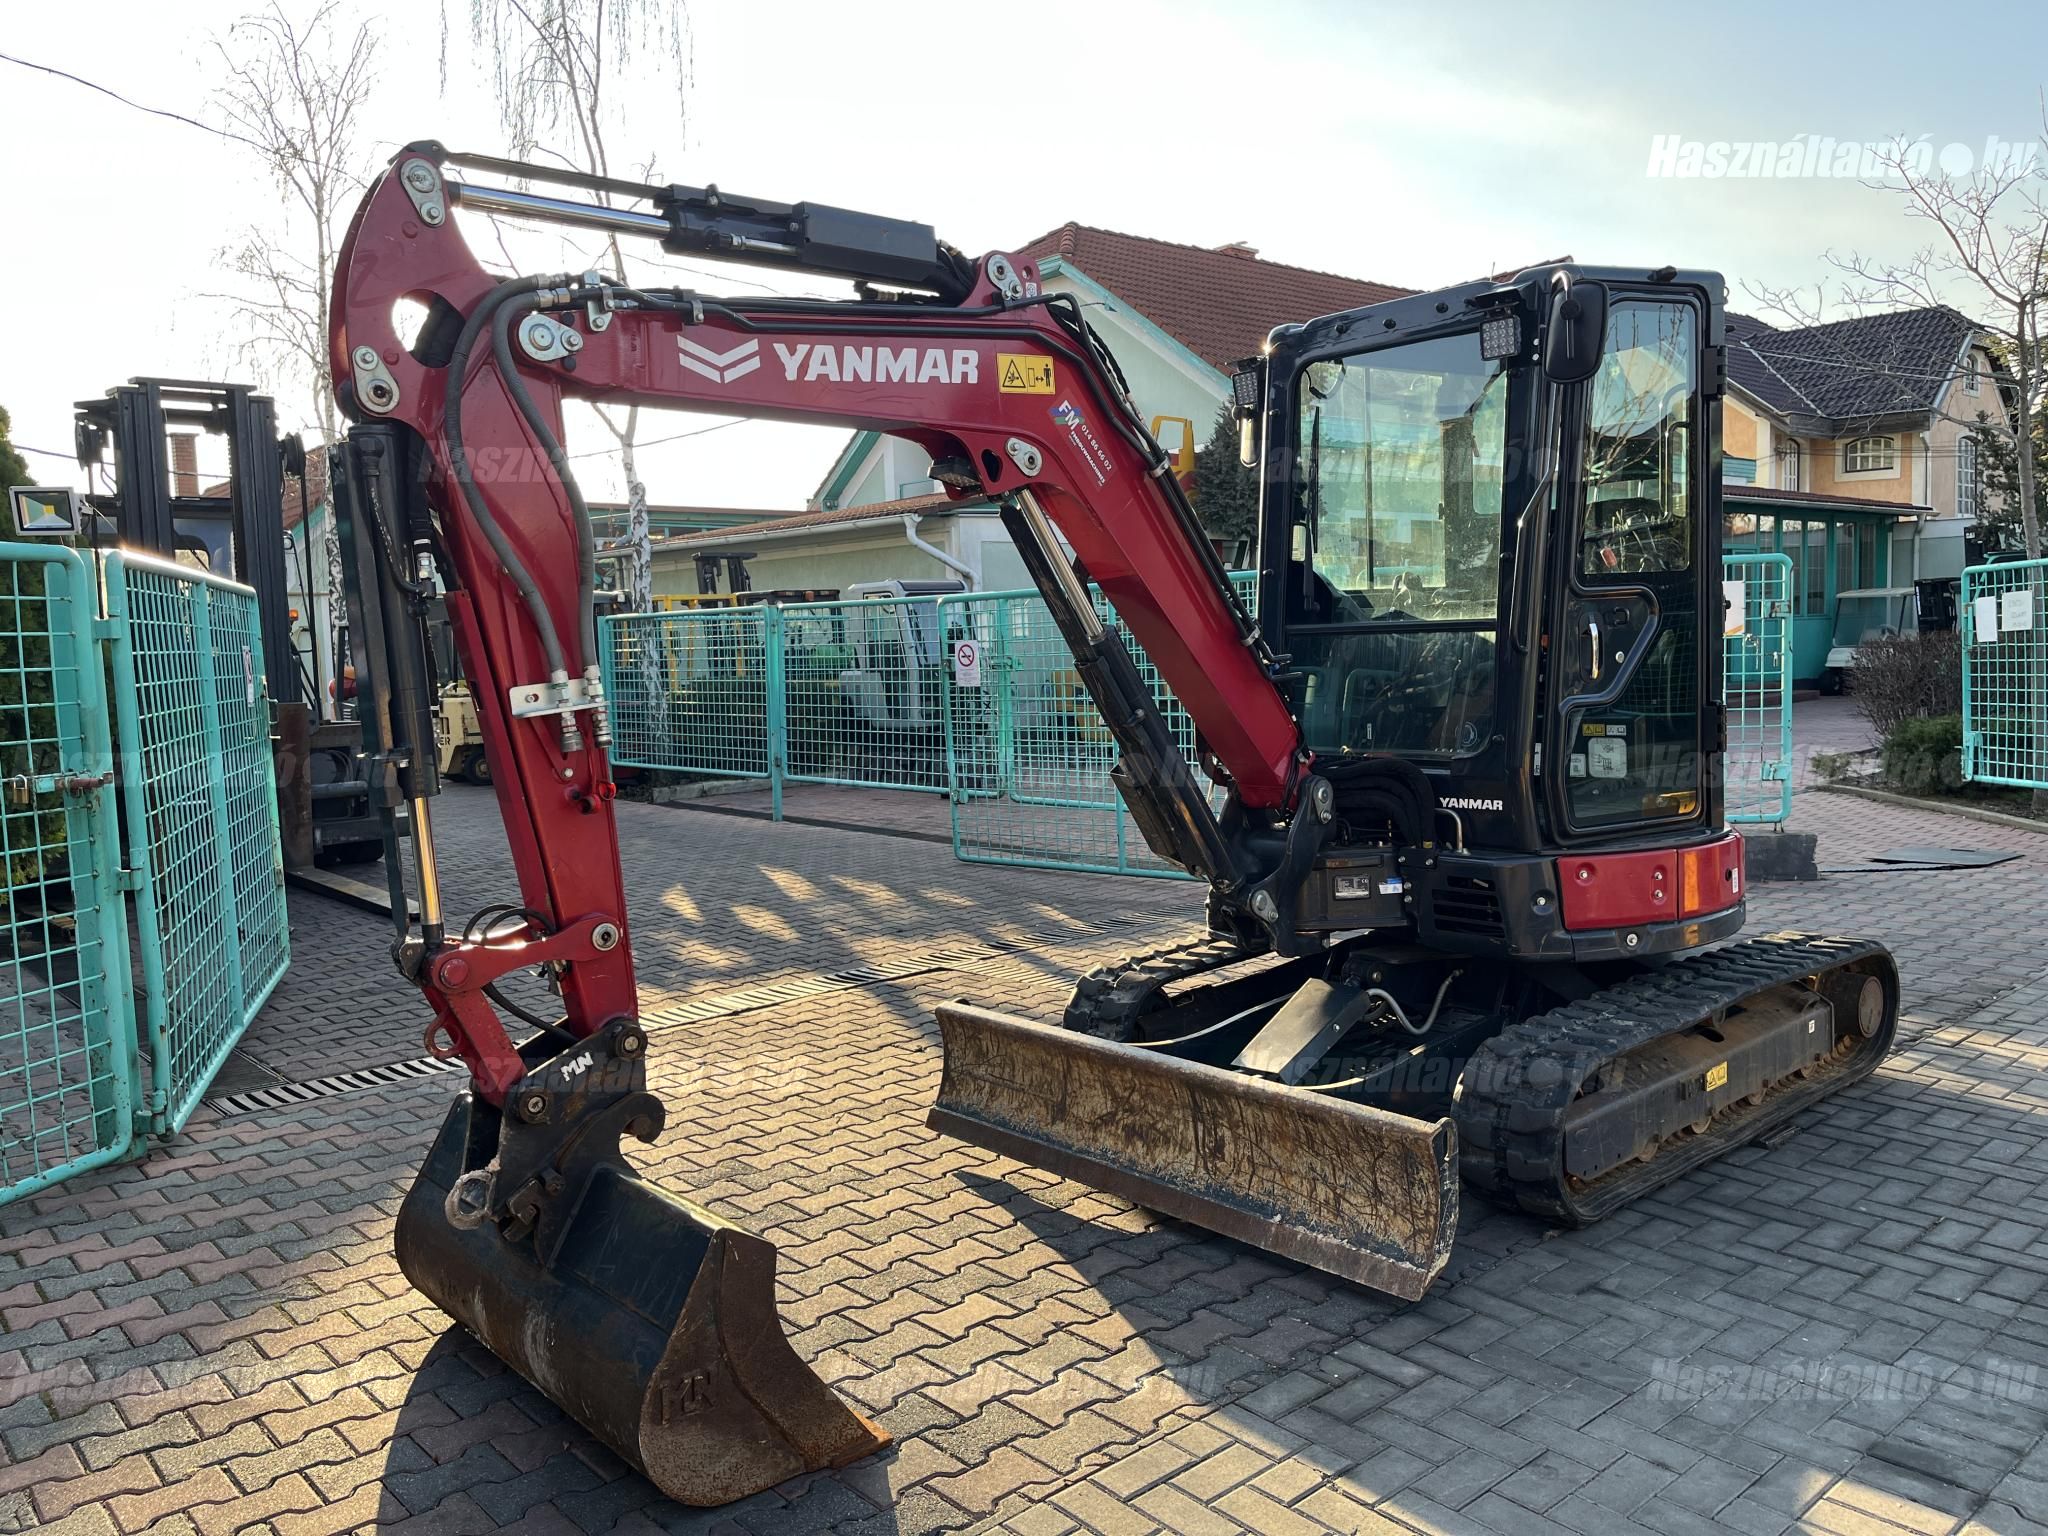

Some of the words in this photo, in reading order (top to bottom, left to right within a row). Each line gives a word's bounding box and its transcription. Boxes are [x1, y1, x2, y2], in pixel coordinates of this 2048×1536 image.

[773, 343, 978, 384] YANMAR
[1058, 400, 1080, 430] FM
[1439, 797, 1503, 811] YANMAR
